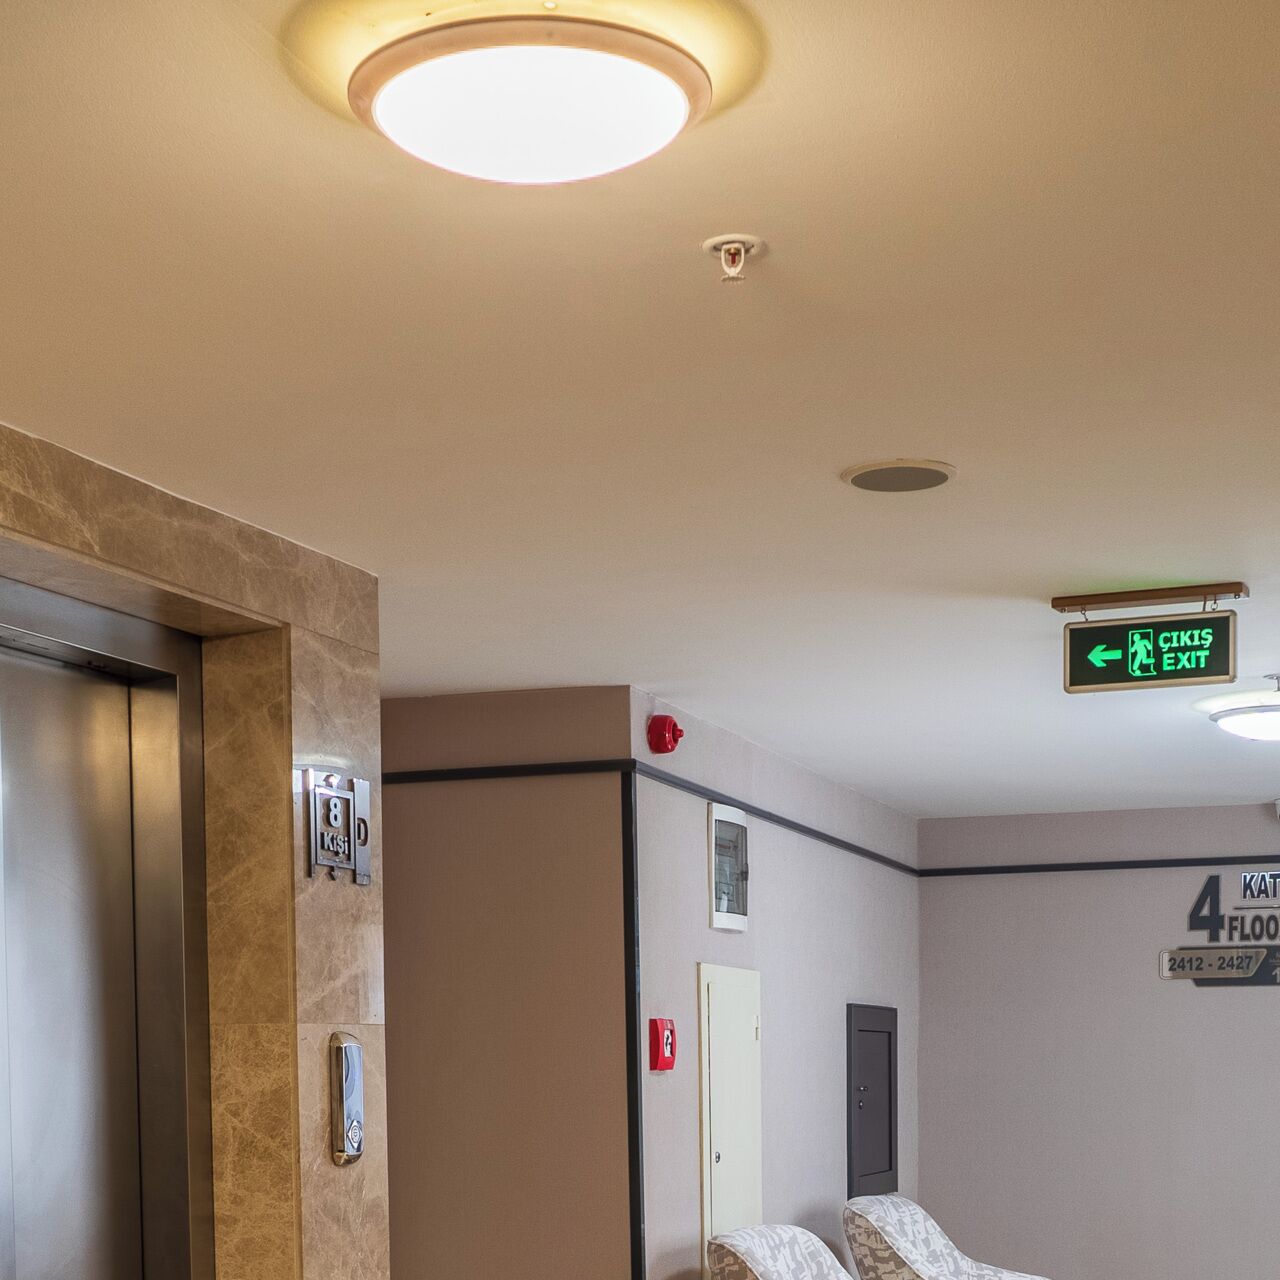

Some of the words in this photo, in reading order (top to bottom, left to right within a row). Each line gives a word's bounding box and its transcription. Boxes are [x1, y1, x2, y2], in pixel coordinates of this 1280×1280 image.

[1158, 628, 1213, 652] ÇIKIŞ
[1162, 650, 1210, 671] EXIT
[329, 797, 342, 828] 8
[356, 817, 369, 847] D
[1189, 874, 1225, 943] 4
[1168, 957, 1204, 972] 2412
[1217, 955, 1253, 971] 2427
